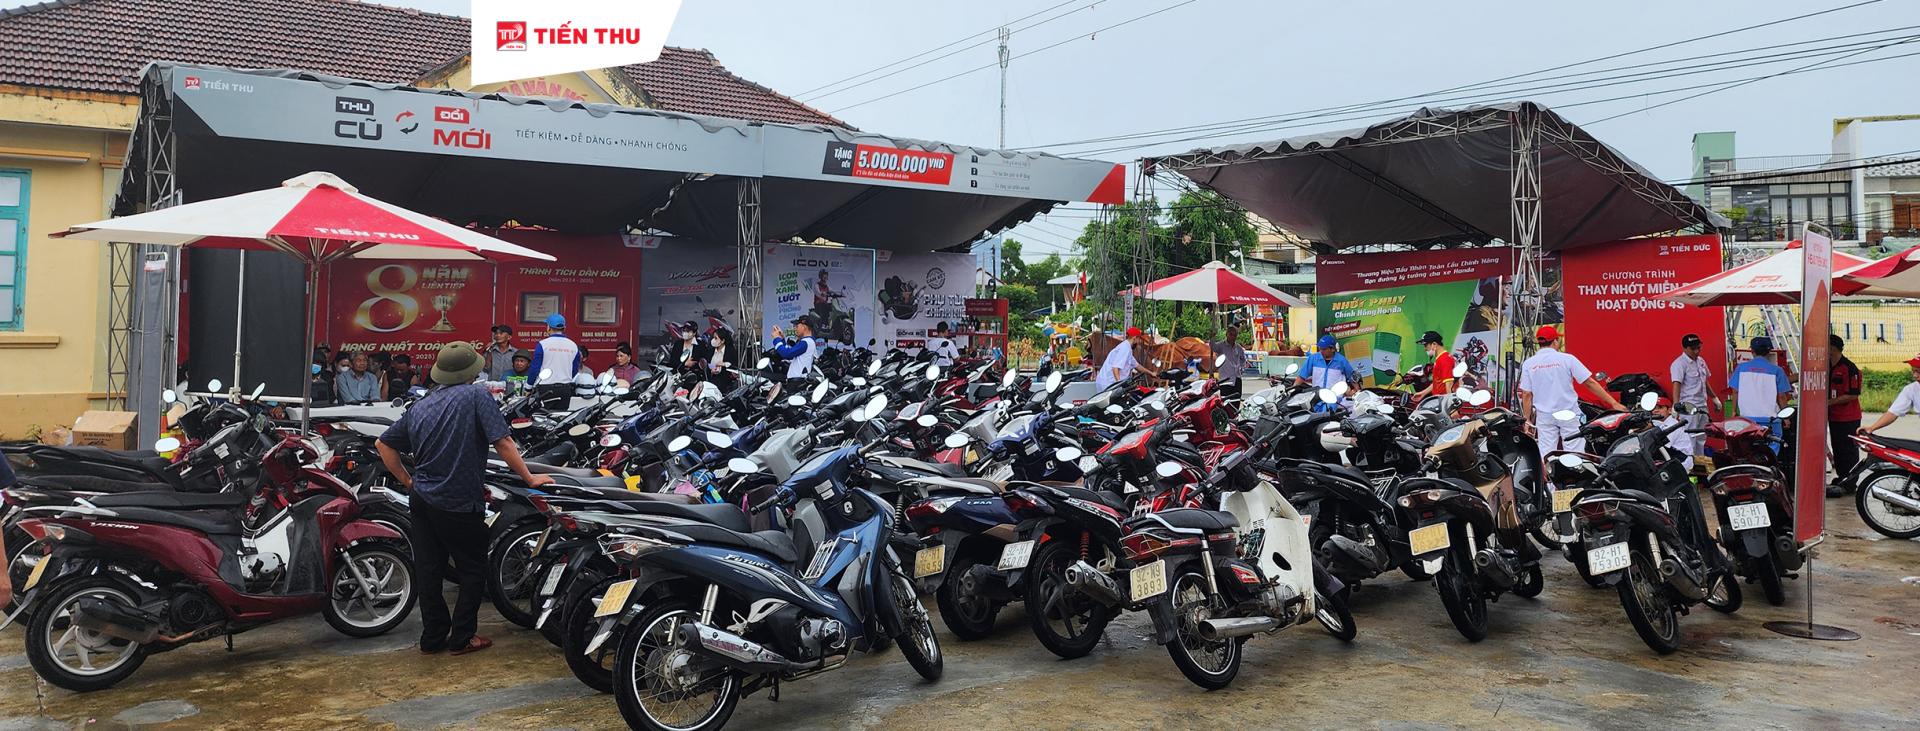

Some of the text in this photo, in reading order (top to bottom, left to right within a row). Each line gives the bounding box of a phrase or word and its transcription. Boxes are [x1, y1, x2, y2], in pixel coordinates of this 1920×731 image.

[203, 79, 254, 93] TIẾN THU
[339, 100, 370, 111] THU
[439, 108, 464, 121] ĐỔI
[335, 117, 383, 141] CŨ
[433, 127, 491, 150] MỚI
[516, 129, 688, 152] TIẾT KIỆM DỄ DÀNG NHANH CHÓNG
[834, 147, 853, 160] TẶNG
[858, 150, 928, 174] 5.000.000
[372, 231, 420, 240] THU
[1670, 243, 1711, 253] TIẾN ĐỨC
[793, 259, 829, 267] ICON
[1357, 271, 1380, 279] Thương
[1461, 259, 1479, 267] Chính
[1482, 257, 1500, 265] Hãng
[421, 265, 471, 281] NĂM
[554, 267, 577, 276] TÍCH
[779, 272, 798, 280] ICON
[1378, 274, 1397, 284] đường
[1407, 271, 1427, 281] tưởng
[1602, 268, 1676, 280] CHƯƠNG TRÌNH
[776, 285, 798, 294] XANH
[1578, 285, 1609, 296] THAY
[1611, 281, 1645, 294] NHỚT
[353, 264, 420, 332] 8
[1332, 295, 1406, 311] NHỚT PHUY
[1596, 297, 1685, 312] HOẠT ĐỘNG 4S
[1335, 305, 1402, 319] Chính Hãng Honda
[379, 340, 416, 351] NHẤT
[1734, 505, 1762, 518] 92-H1
[90, 522, 139, 530] VISION
[1594, 545, 1622, 561] 92-H1
[724, 553, 771, 569] FUTURE
[1137, 578, 1163, 597] 3893
